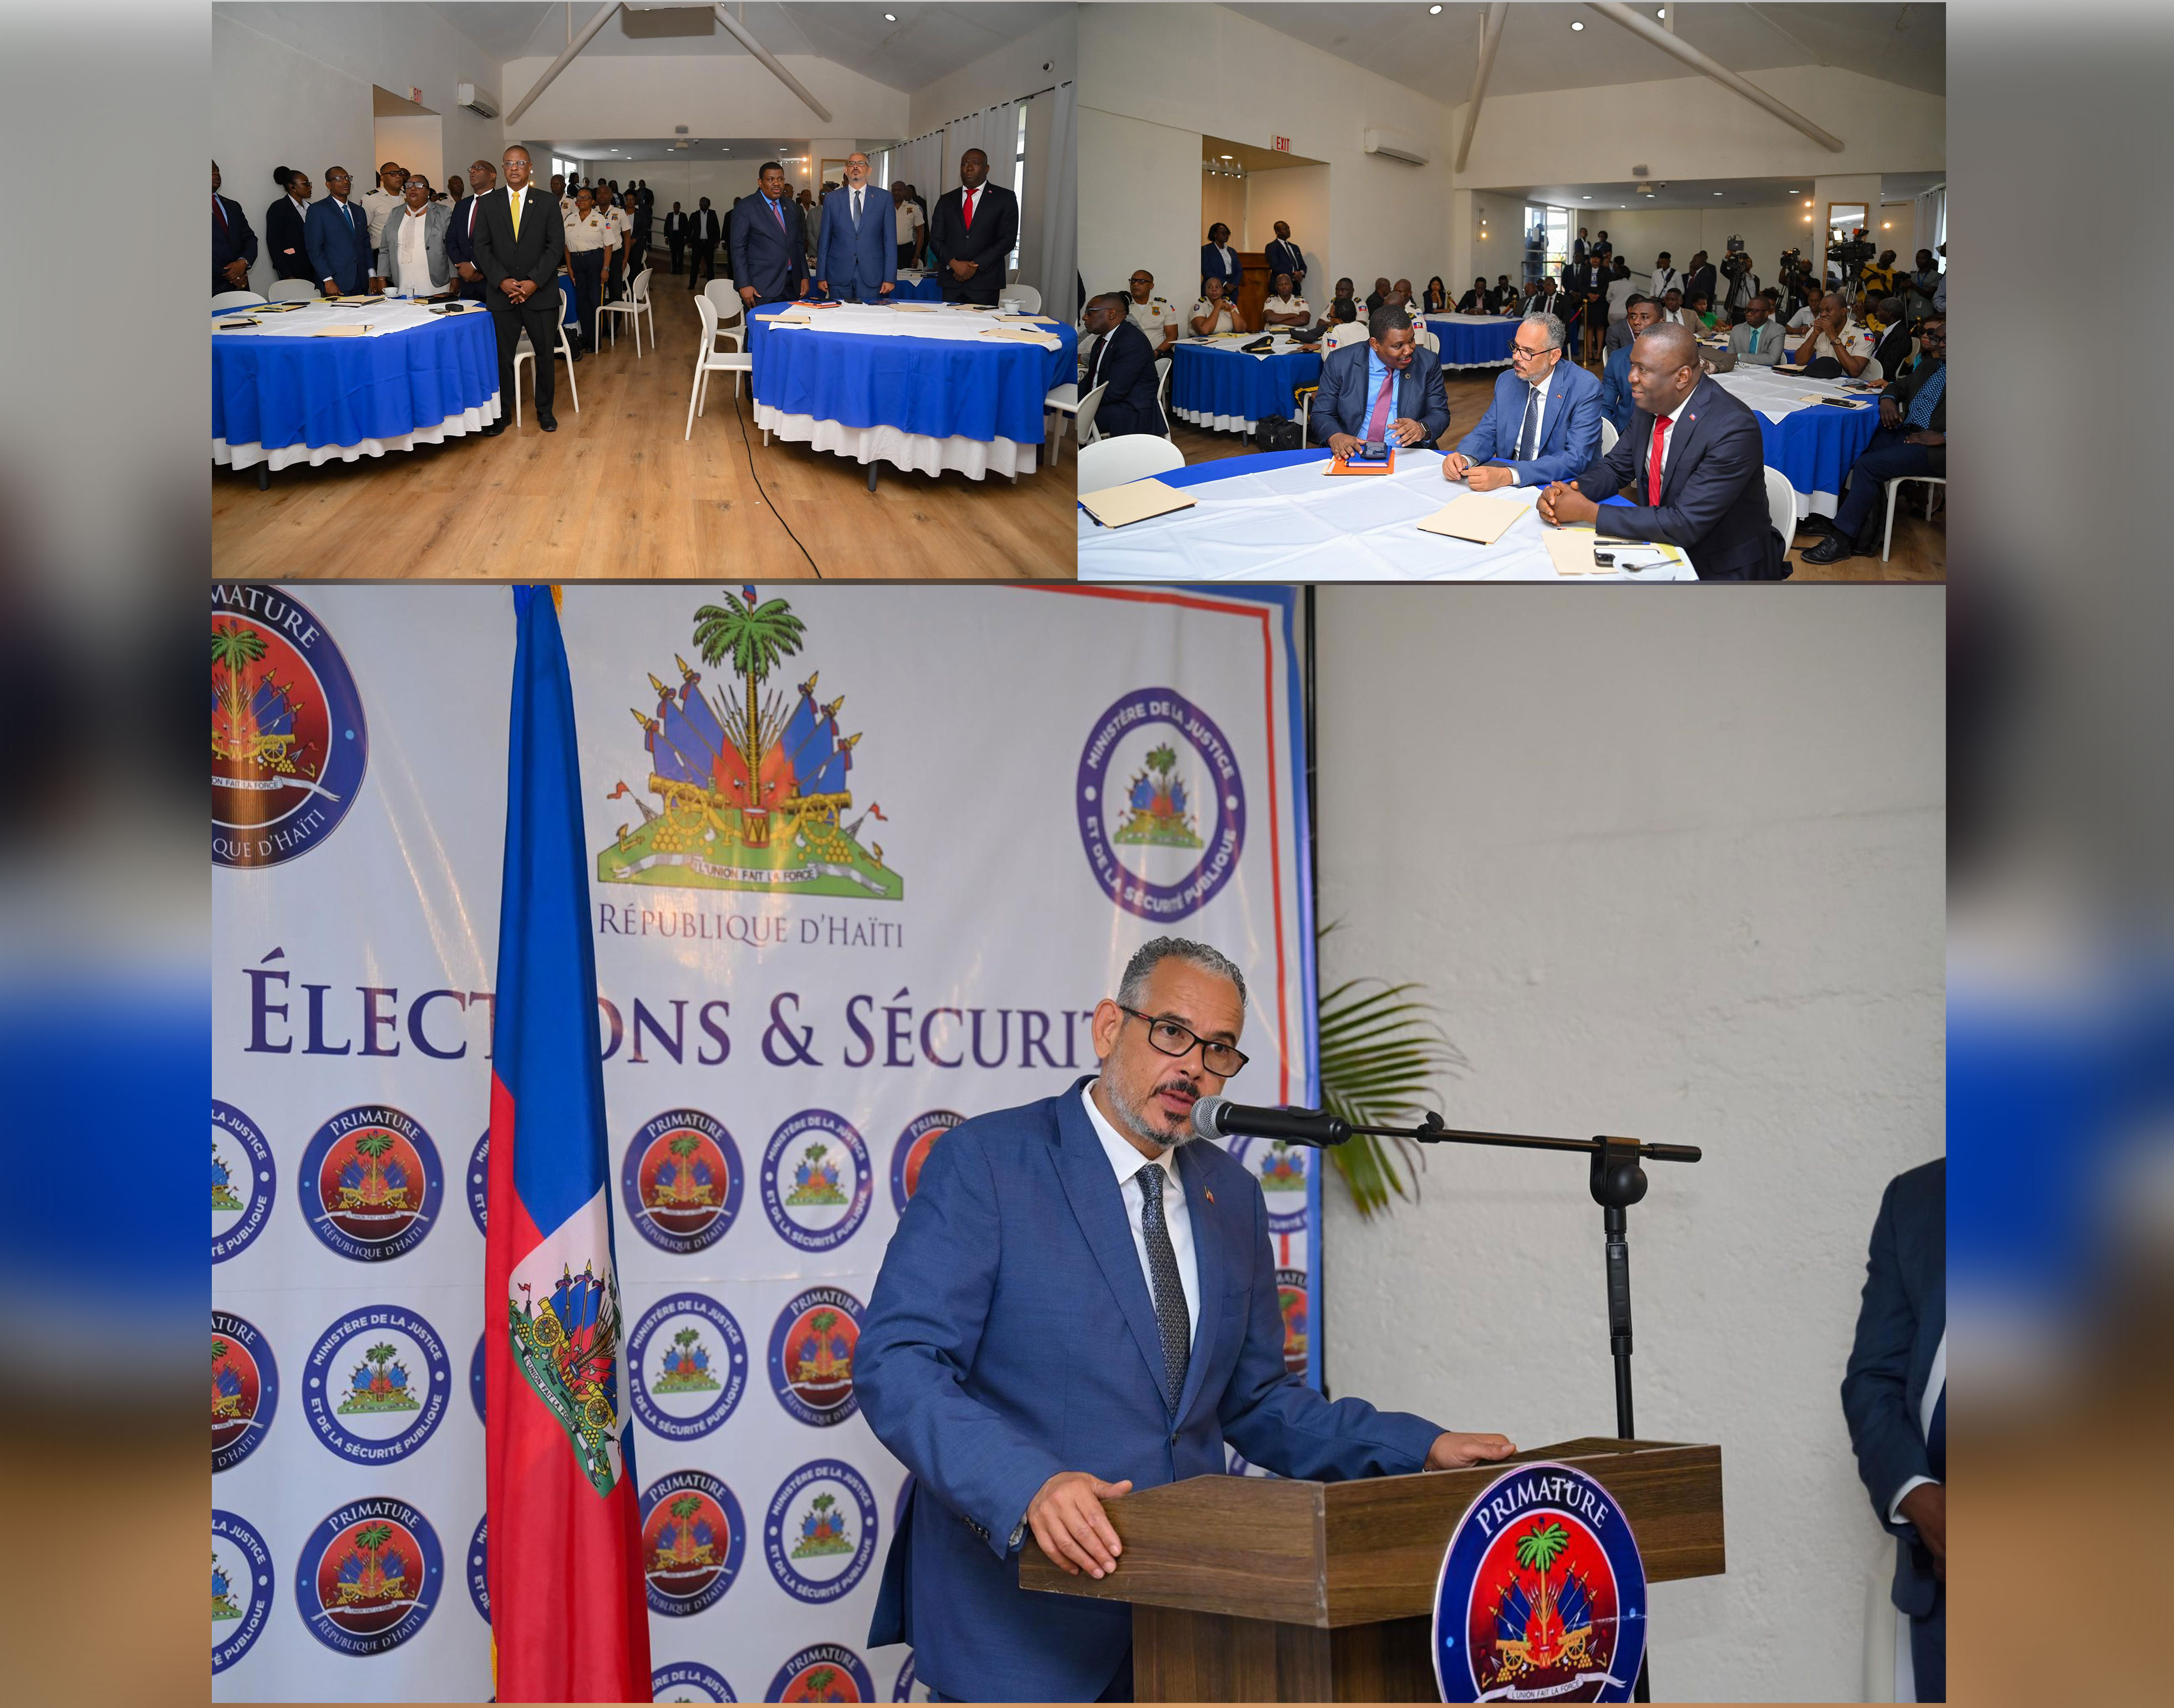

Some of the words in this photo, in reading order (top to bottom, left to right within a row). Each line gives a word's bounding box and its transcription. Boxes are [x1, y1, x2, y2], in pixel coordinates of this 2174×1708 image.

[1277, 136, 1289, 151] EXIT
[1087, 701, 1146, 769] MINISTÈRE
[1150, 701, 1170, 715] DE
[1171, 704, 1184, 723] LA
[1185, 718, 1234, 780] JUSTICE
[226, 779, 241, 787] FAIT
[258, 809, 326, 856] D'HAÏTI
[699, 862, 738, 878] L'UNION
[742, 870, 763, 881] FAIT
[768, 871, 779, 881] LA
[783, 869, 814, 881] FORCE
[1087, 816, 1098, 840] ET
[1093, 843, 1108, 868] DE
[1104, 869, 1121, 893] LA
[1124, 888, 1185, 914] SÉCURITÉ
[1185, 829, 1237, 905] PUBLIQUE
[598, 902, 788, 947] RÉPUBLIQUE
[800, 913, 903, 947] D'HAÏTI
[242, 946, 730, 1065] ÉLECTNS
[761, 992, 824, 1066] &
[212, 1110, 226, 1122] LA
[228, 1118, 267, 1161] JUSTICE
[329, 1110, 420, 1141] PRIMATURE
[647, 1114, 724, 1141] PRIMATURE
[768, 1119, 806, 1162] MINISTÈRE
[807, 1117, 820, 1126] DE
[822, 1118, 835, 1128] LA
[836, 1124, 866, 1161] JUSTICE
[475, 1193, 485, 1208] ET
[767, 1190, 776, 1204] ET
[226, 1195, 267, 1250] PUBLIQUE
[771, 1208, 783, 1223] DE
[779, 1221, 791, 1236] LA
[837, 1191, 868, 1239] PUBLIQUE
[321, 1223, 382, 1260] RÉPUBLIQUE
[385, 1226, 422, 1255] D'HAÏTI
[791, 1231, 836, 1247] SÉCURITÉ
[790, 1290, 860, 1316] PRIMATURE
[313, 1316, 368, 1366] MINISTÈRE
[371, 1314, 387, 1324] DE
[390, 1315, 405, 1327] LA
[407, 1321, 443, 1361] JUSTICE
[632, 1303, 675, 1349] MINISTÈRE
[677, 1301, 692, 1310] DE
[694, 1302, 707, 1313] LA
[708, 1308, 741, 1345] JUSTICE
[525, 1358, 542, 1385] L'UNION
[541, 1386, 553, 1399] FAIT
[552, 1399, 561, 1409] LA
[631, 1379, 642, 1394] ET
[311, 1397, 323, 1414] ET
[636, 1396, 648, 1411] DE
[708, 1375, 741, 1427] PUBLIQUE
[316, 1416, 332, 1434] DE
[404, 1394, 443, 1449] PUBLIQUE
[645, 1410, 658, 1425] LA
[657, 1420, 707, 1435] SÉCURITÉ
[218, 1434, 256, 1467] D'HAÏTI
[328, 1431, 343, 1447] LA
[344, 1441, 403, 1458] SÉCURITÉ
[649, 1474, 727, 1502] PRIMATURE
[772, 1470, 814, 1516] MINISTÈRE
[815, 1467, 829, 1477] DE
[830, 1467, 842, 1478] LA
[843, 1472, 872, 1508] JUSTICE
[328, 1502, 420, 1532] PRIMATURE
[1475, 1476, 1609, 1538] PRIMATURE
[212, 1519, 227, 1531] LA
[229, 1525, 266, 1565] JUSTICE
[474, 1574, 485, 1590] ET
[770, 1544, 780, 1559] ET
[775, 1560, 787, 1577] DE
[783, 1574, 797, 1589] LA
[796, 1583, 842, 1598] SÉCURITÉ
[841, 1538, 872, 1589] PUBLIQUE
[224, 1600, 265, 1660] PUBLIQUE
[318, 1620, 378, 1653] RÉPUBLIQUE
[671, 1670, 686, 1681] DE
[688, 1670, 700, 1681] LA
[786, 1647, 858, 1676] PRIMATURE
[1512, 1691, 1535, 1699] L'UNION
[1537, 1689, 1550, 1698] FAIT
[1561, 1680, 1581, 1693] FORCE
